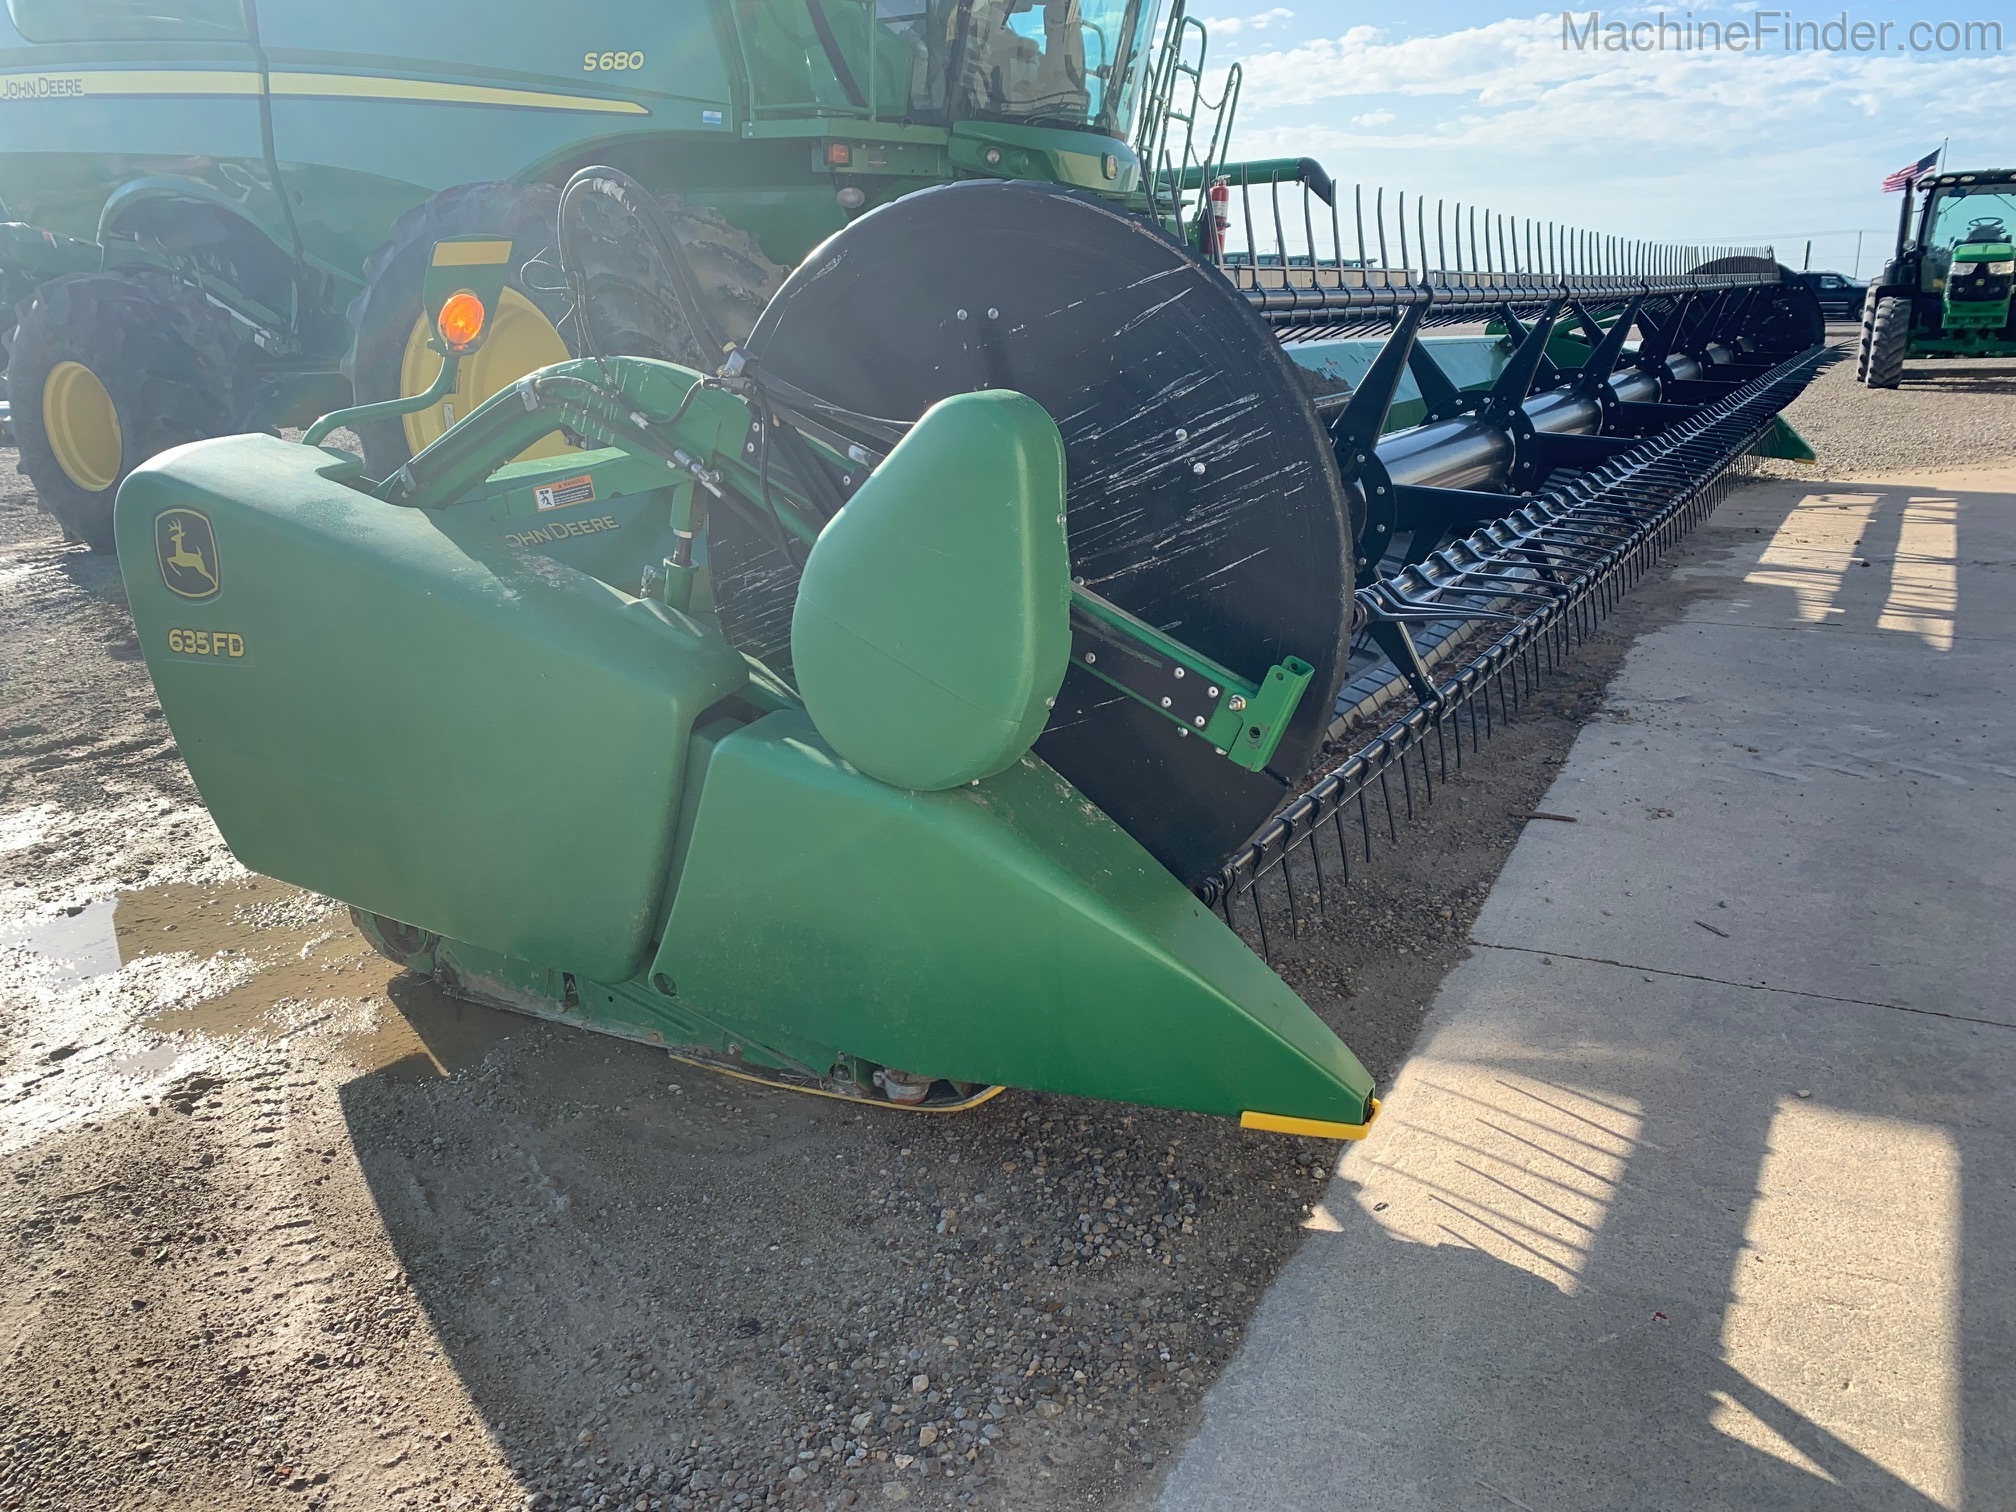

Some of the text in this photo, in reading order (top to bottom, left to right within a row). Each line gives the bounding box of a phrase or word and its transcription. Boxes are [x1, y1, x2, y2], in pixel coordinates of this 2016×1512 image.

[583, 50, 645, 71] S680
[2, 76, 83, 98] JOHN DEERE
[504, 515, 620, 546] OHN DEERE
